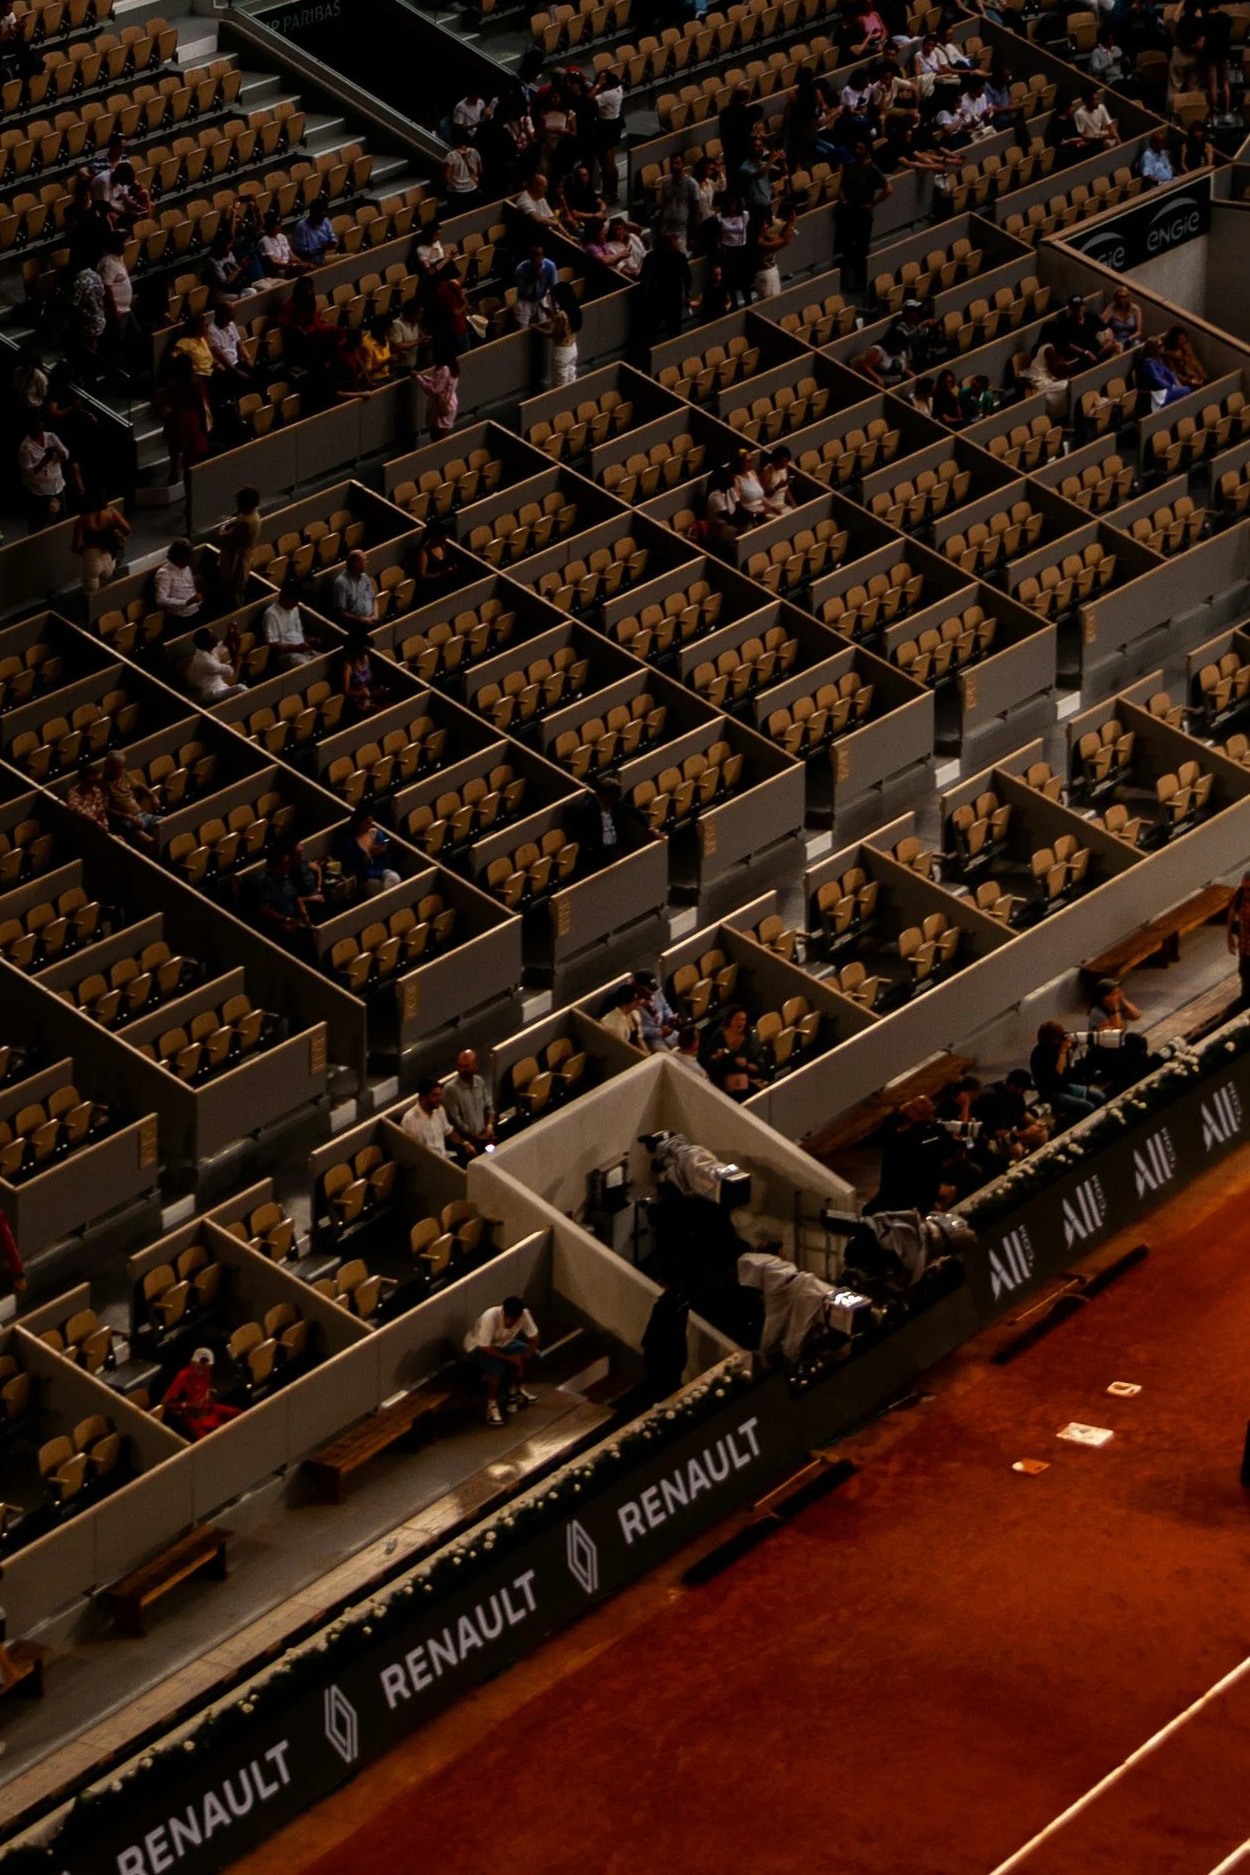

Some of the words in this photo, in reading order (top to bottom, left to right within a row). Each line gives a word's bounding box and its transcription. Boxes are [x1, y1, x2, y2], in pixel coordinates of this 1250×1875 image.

[617, 1416, 761, 1545] RENAULT
[380, 1569, 538, 1709] RENAULT
[115, 1739, 292, 1875] RENAULT
